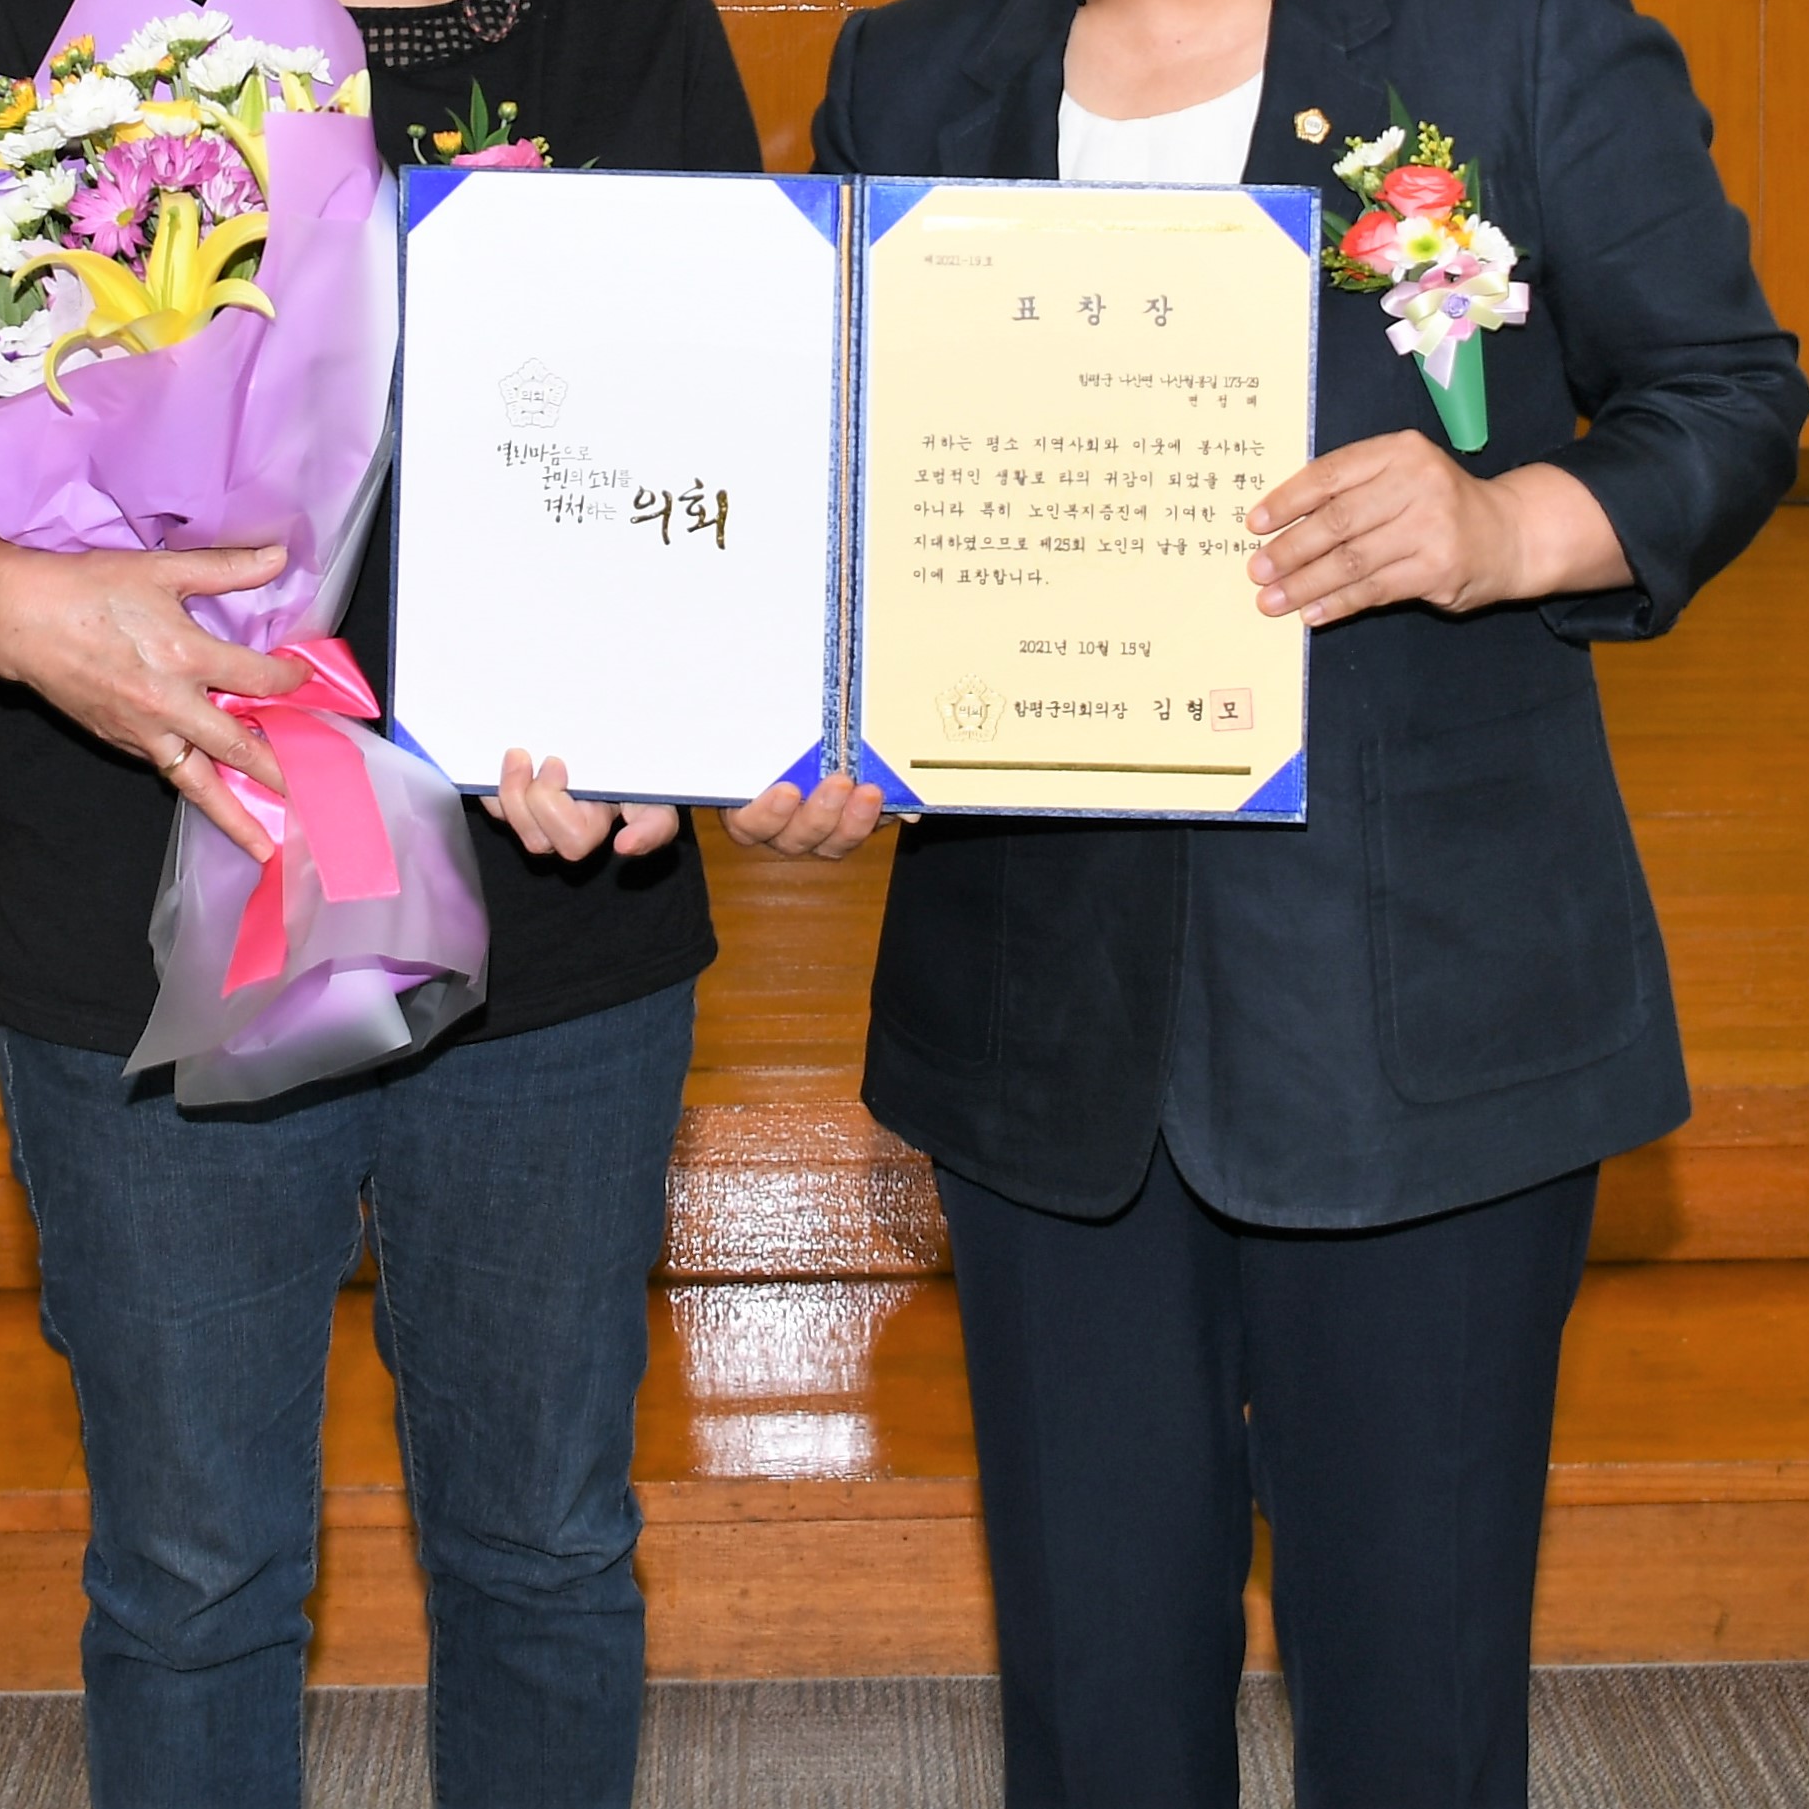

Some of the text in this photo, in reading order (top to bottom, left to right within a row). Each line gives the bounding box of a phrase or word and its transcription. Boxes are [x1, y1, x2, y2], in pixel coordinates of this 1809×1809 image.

[922, 434, 1265, 457] 귀하는 평소 지역사회와 이웃에 봉사하는
[914, 468, 980, 486] 모범적인
[1059, 469, 1090, 486] 타의
[1104, 470, 1153, 489] 귀감이
[1168, 471, 1219, 491] 되었을
[1232, 473, 1265, 491] 뿐만
[544, 478, 728, 550] 경청하는 의회
[913, 501, 965, 518] 아니라
[979, 501, 1011, 519] 특히
[1028, 503, 1147, 522] 노인복지증진에
[1165, 504, 1216, 523] 기여한
[914, 534, 1029, 552] 지대하였으므로
[1039, 536, 1085, 553] 제25회
[1097, 537, 1144, 555] 노인의
[1156, 537, 1188, 556] 날을
[913, 567, 1049, 586] 이에 표창합니다.
[1019, 639, 1151, 658] 2021년 10월 15일
[1014, 699, 1128, 720] 함평군의회의장
